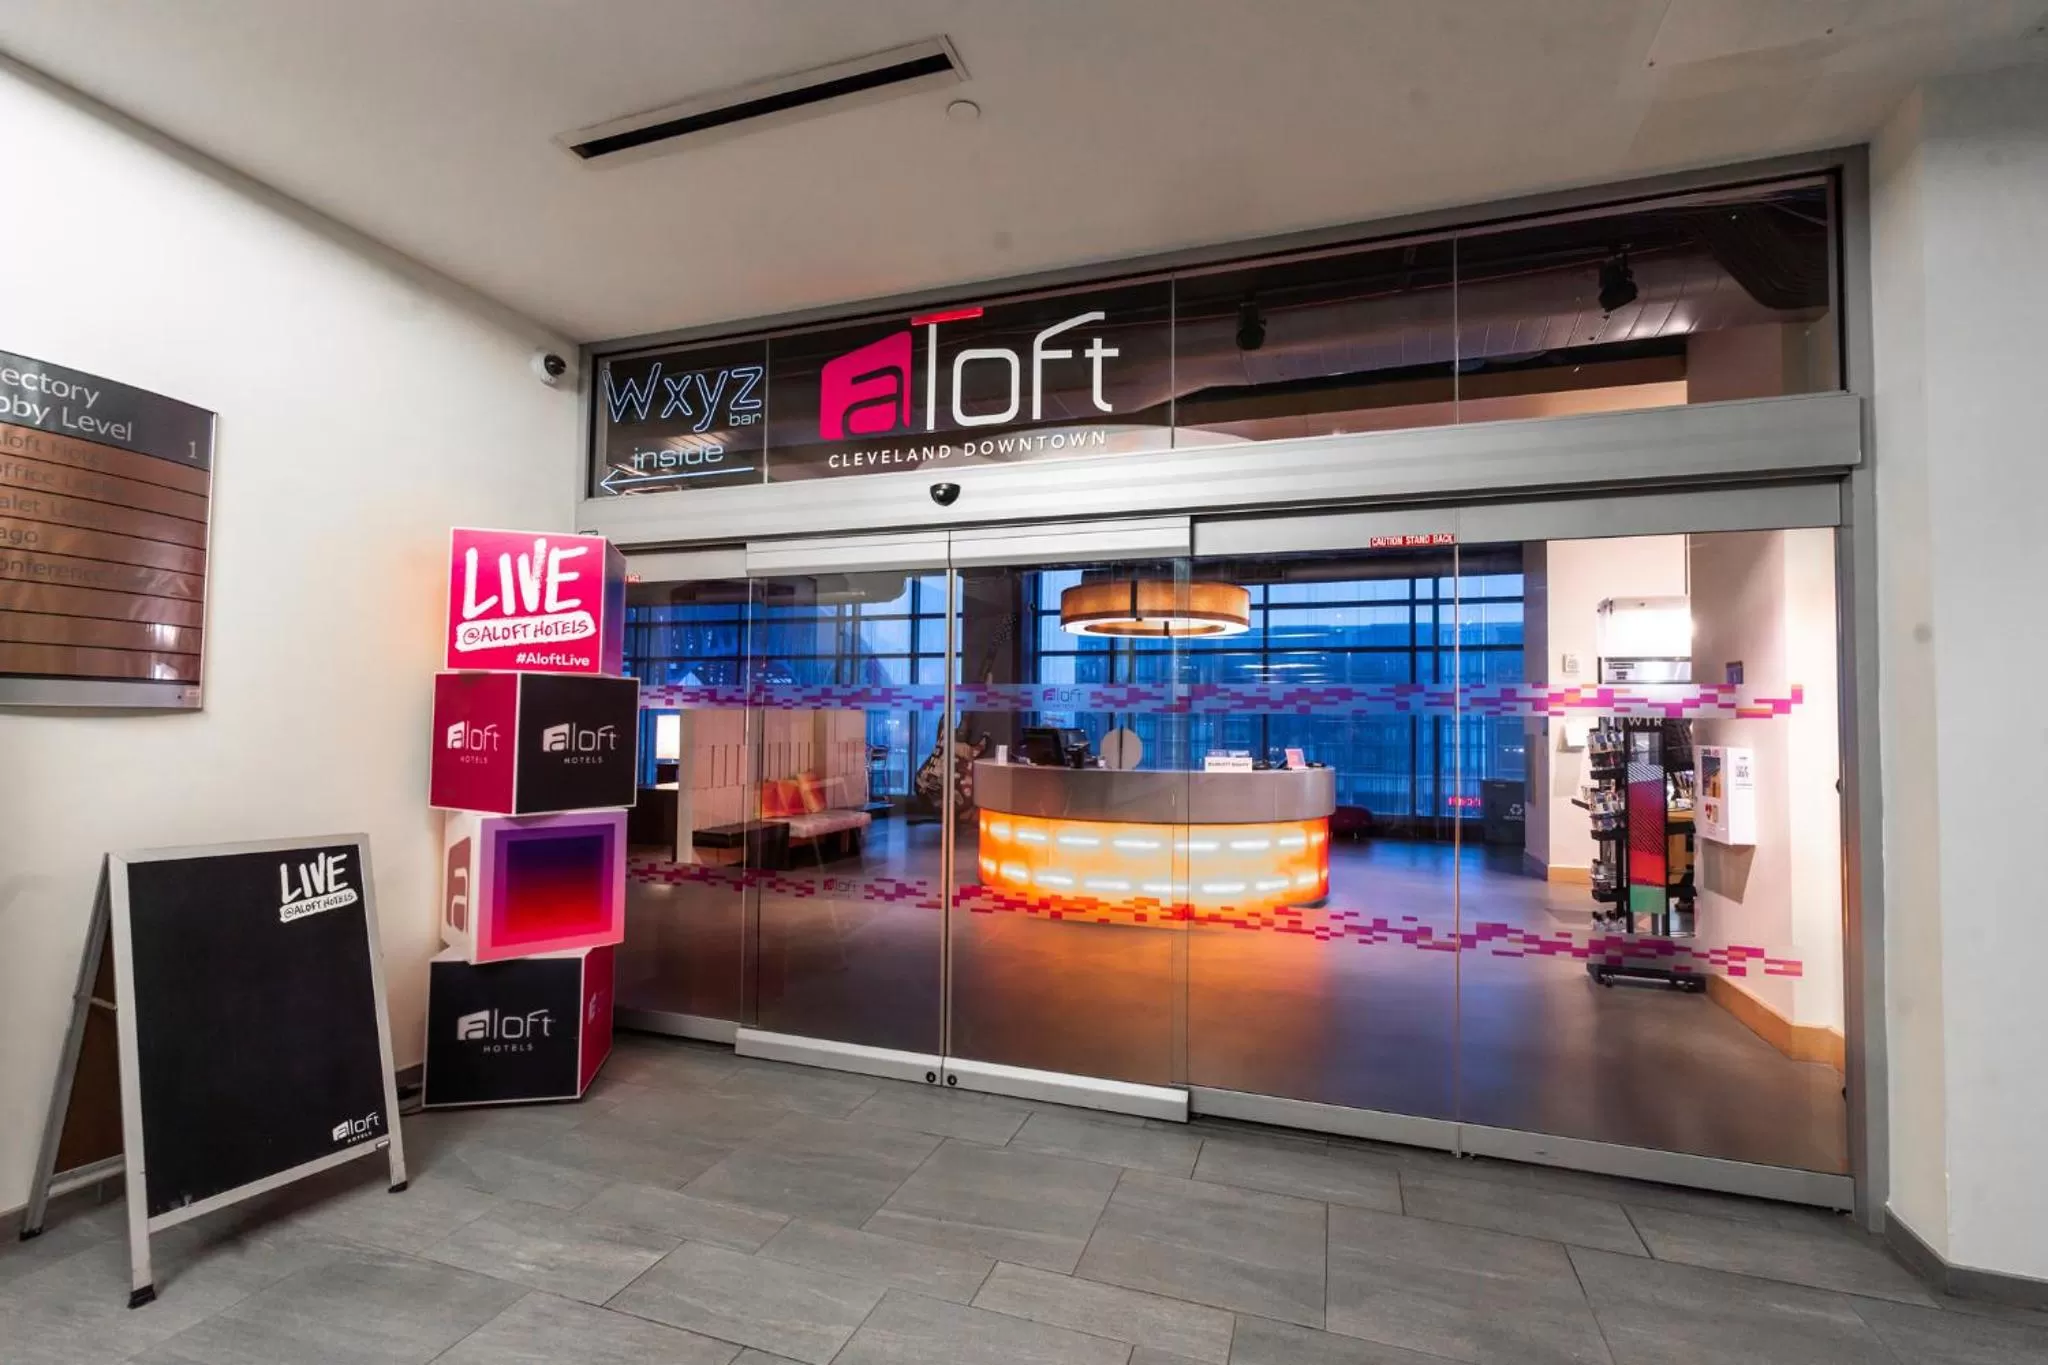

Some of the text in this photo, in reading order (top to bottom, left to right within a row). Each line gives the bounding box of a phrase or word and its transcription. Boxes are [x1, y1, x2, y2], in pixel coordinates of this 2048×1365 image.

[0, 368, 100, 409] ectory
[600, 362, 764, 432] Wxyz
[62, 406, 133, 442] Level
[187, 440, 198, 459] 1
[729, 410, 762, 427] bar
[0, 430, 42, 452] loft
[828, 430, 1108, 470] CLEVELAND DOWNTOWN
[632, 443, 725, 472] inside
[1371, 536, 1403, 548] CAUTION
[1405, 534, 1430, 545] STAND
[462, 537, 589, 620] LIVE
[515, 651, 590, 667] #AloftLive
[447, 720, 500, 751] aloft
[543, 722, 617, 752] aloft
[280, 852, 349, 904] LIVE
[457, 1008, 552, 1040] aloft
[483, 1043, 533, 1052] HOTELS
[332, 1111, 380, 1142] aloft
